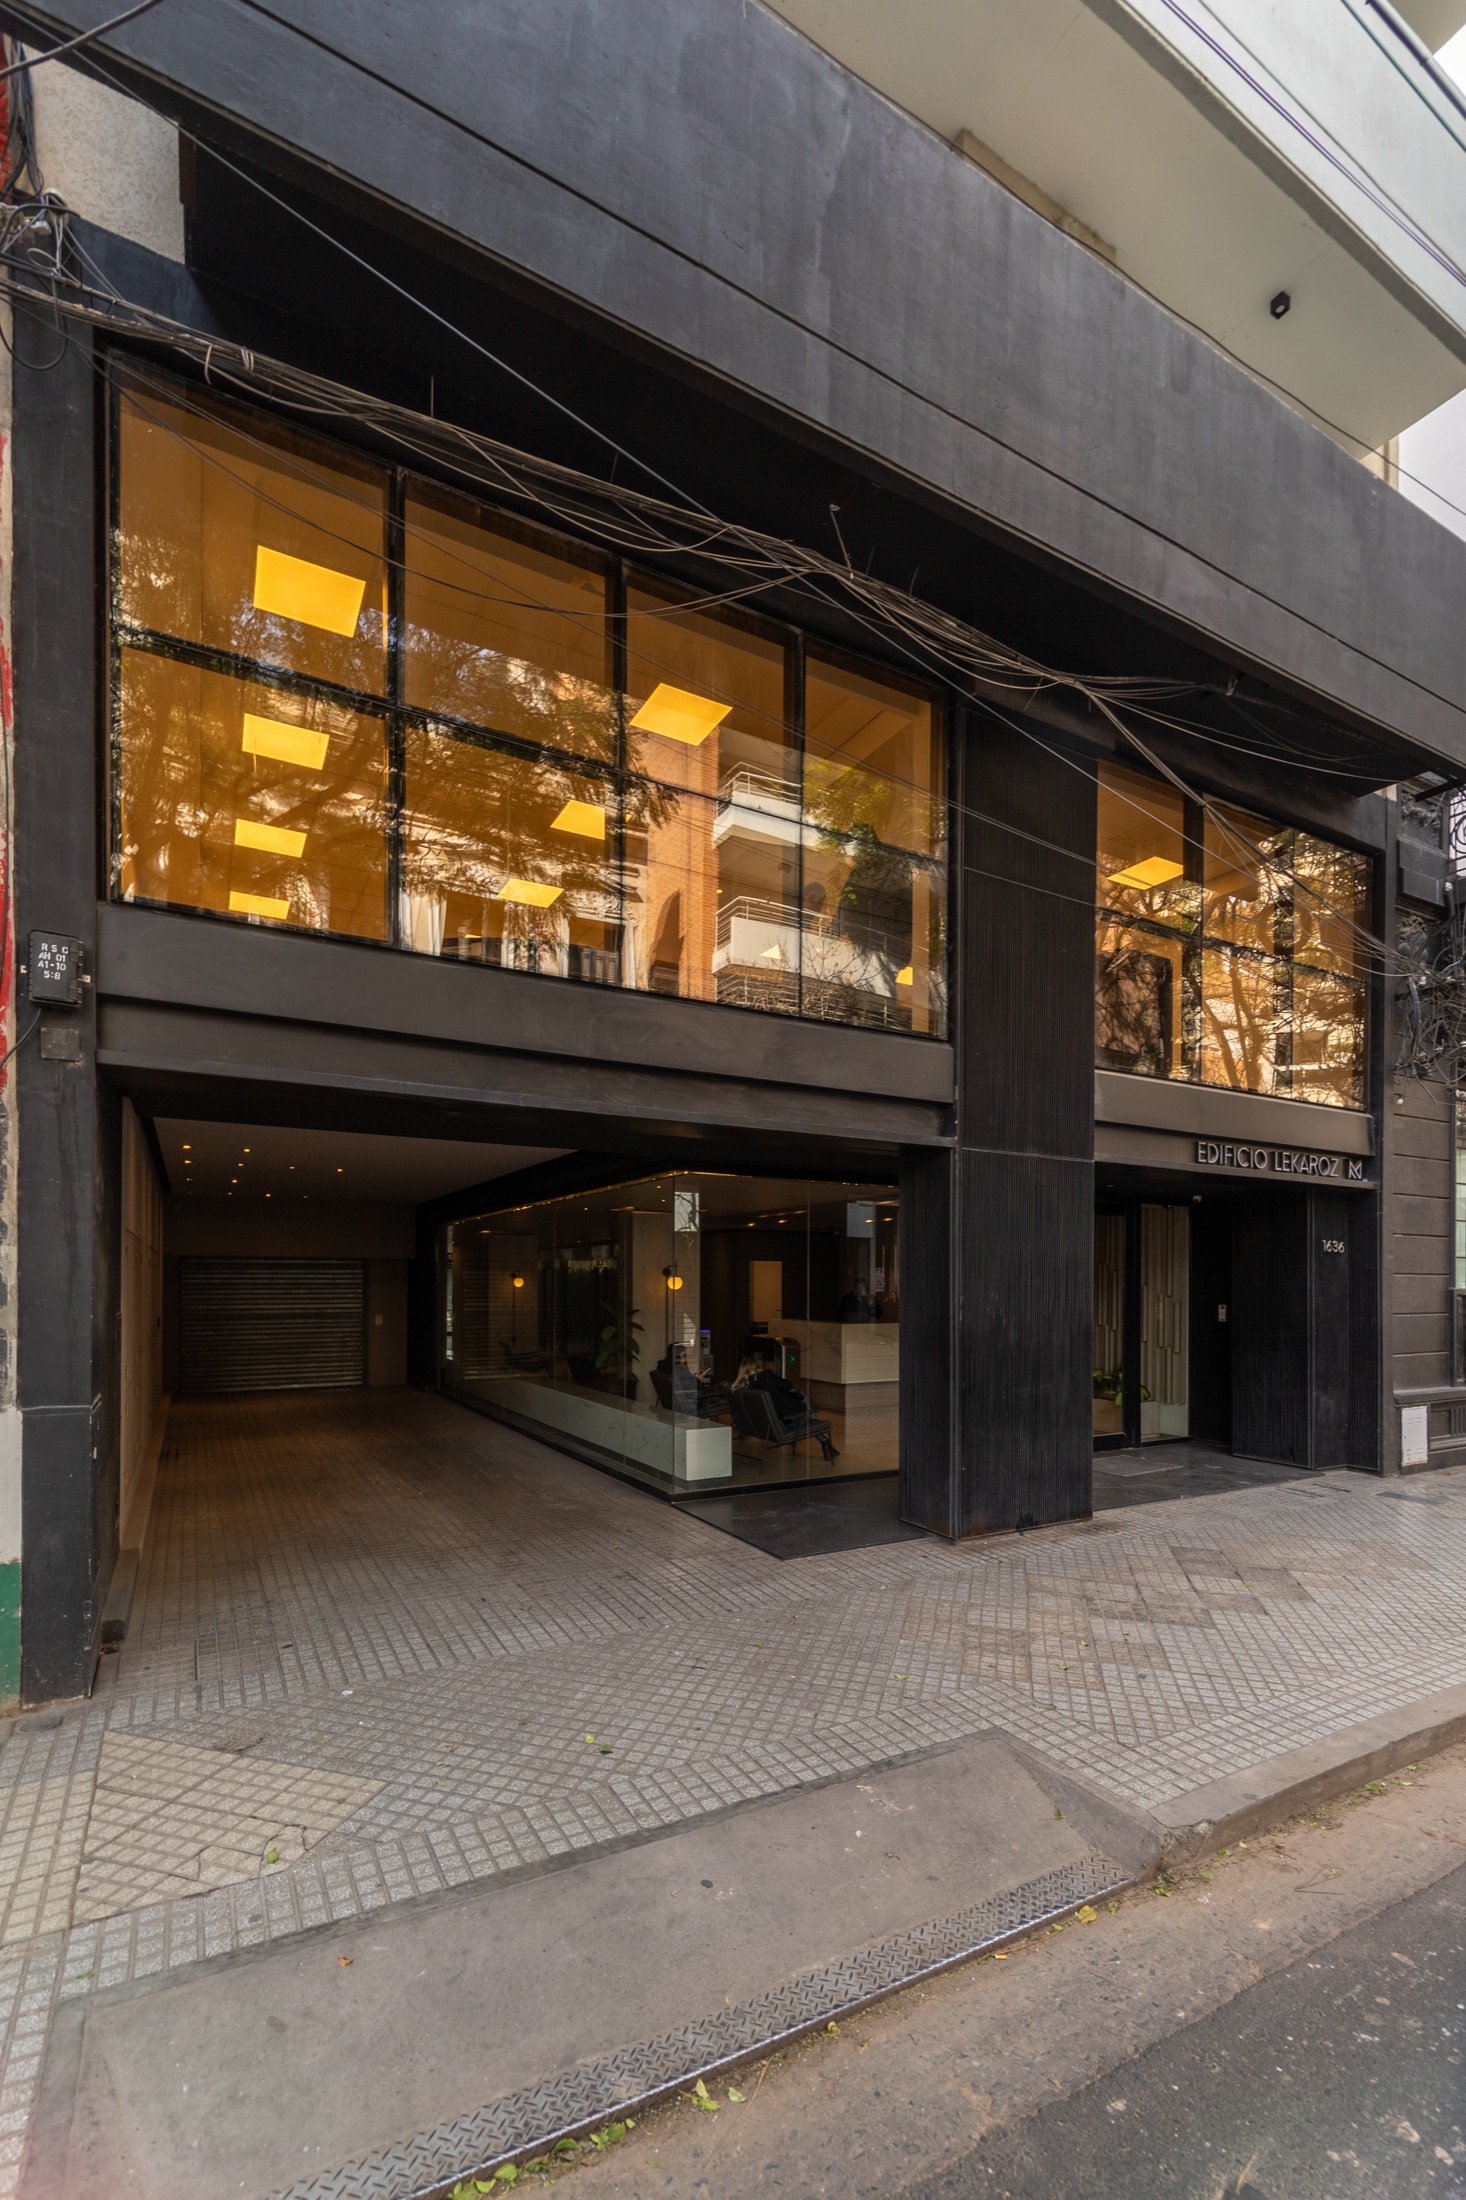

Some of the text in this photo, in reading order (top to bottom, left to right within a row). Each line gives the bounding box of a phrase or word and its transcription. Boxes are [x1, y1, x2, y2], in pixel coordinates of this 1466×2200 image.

[38, 951, 66, 962] AH 01
[43, 970, 61, 980] 5:8
[1197, 1141, 1268, 1170] EDIFICIO
[1273, 1151, 1340, 1178] LEKAROZ
[1321, 1239, 1345, 1254] 1636
